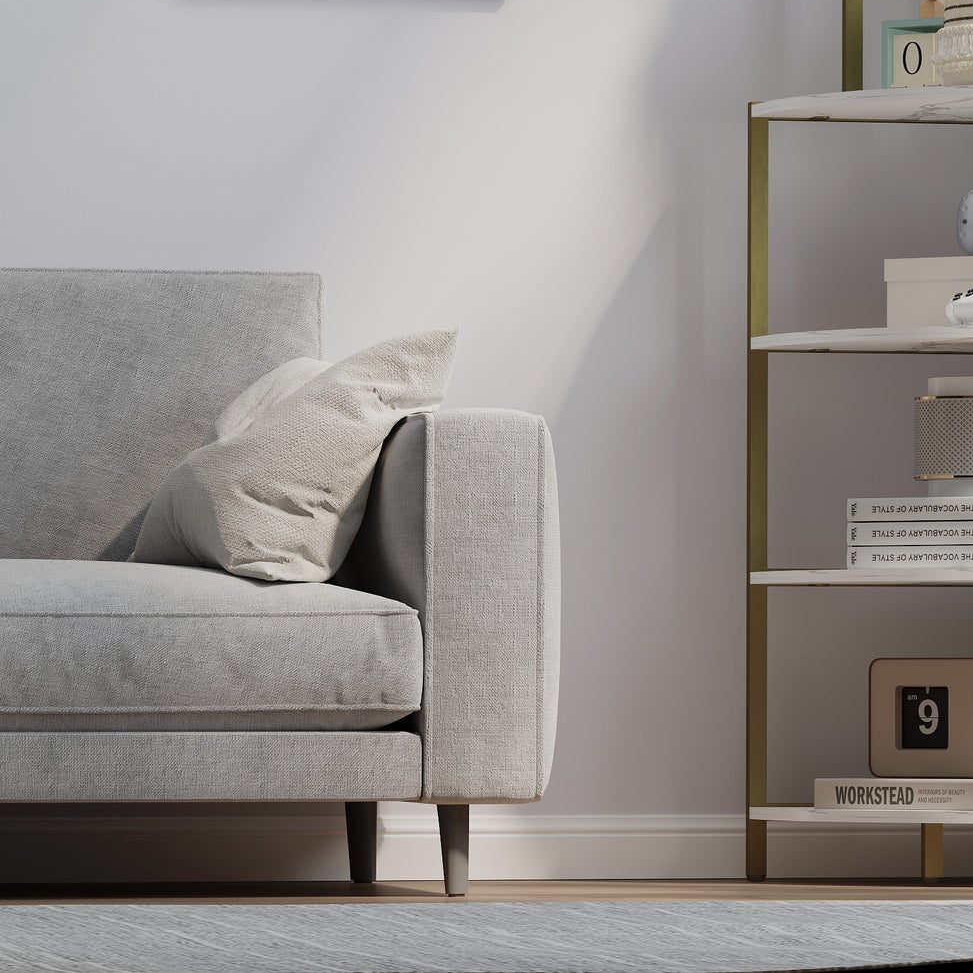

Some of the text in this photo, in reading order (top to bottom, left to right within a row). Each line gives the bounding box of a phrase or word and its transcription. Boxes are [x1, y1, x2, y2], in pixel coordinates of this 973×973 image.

[872, 505, 895, 513] STYLE
[896, 505, 907, 513] OF
[908, 504, 960, 512] VOCABULARY
[872, 530, 895, 538] STYLE
[896, 529, 907, 537] OF
[908, 528, 960, 537] VOCABULARY
[872, 554, 895, 562] STYLE
[896, 554, 907, 562] OF
[908, 553, 960, 561] VOCABULARY
[918, 698, 939, 735] 9
[835, 786, 914, 805] WORKSTEAD
